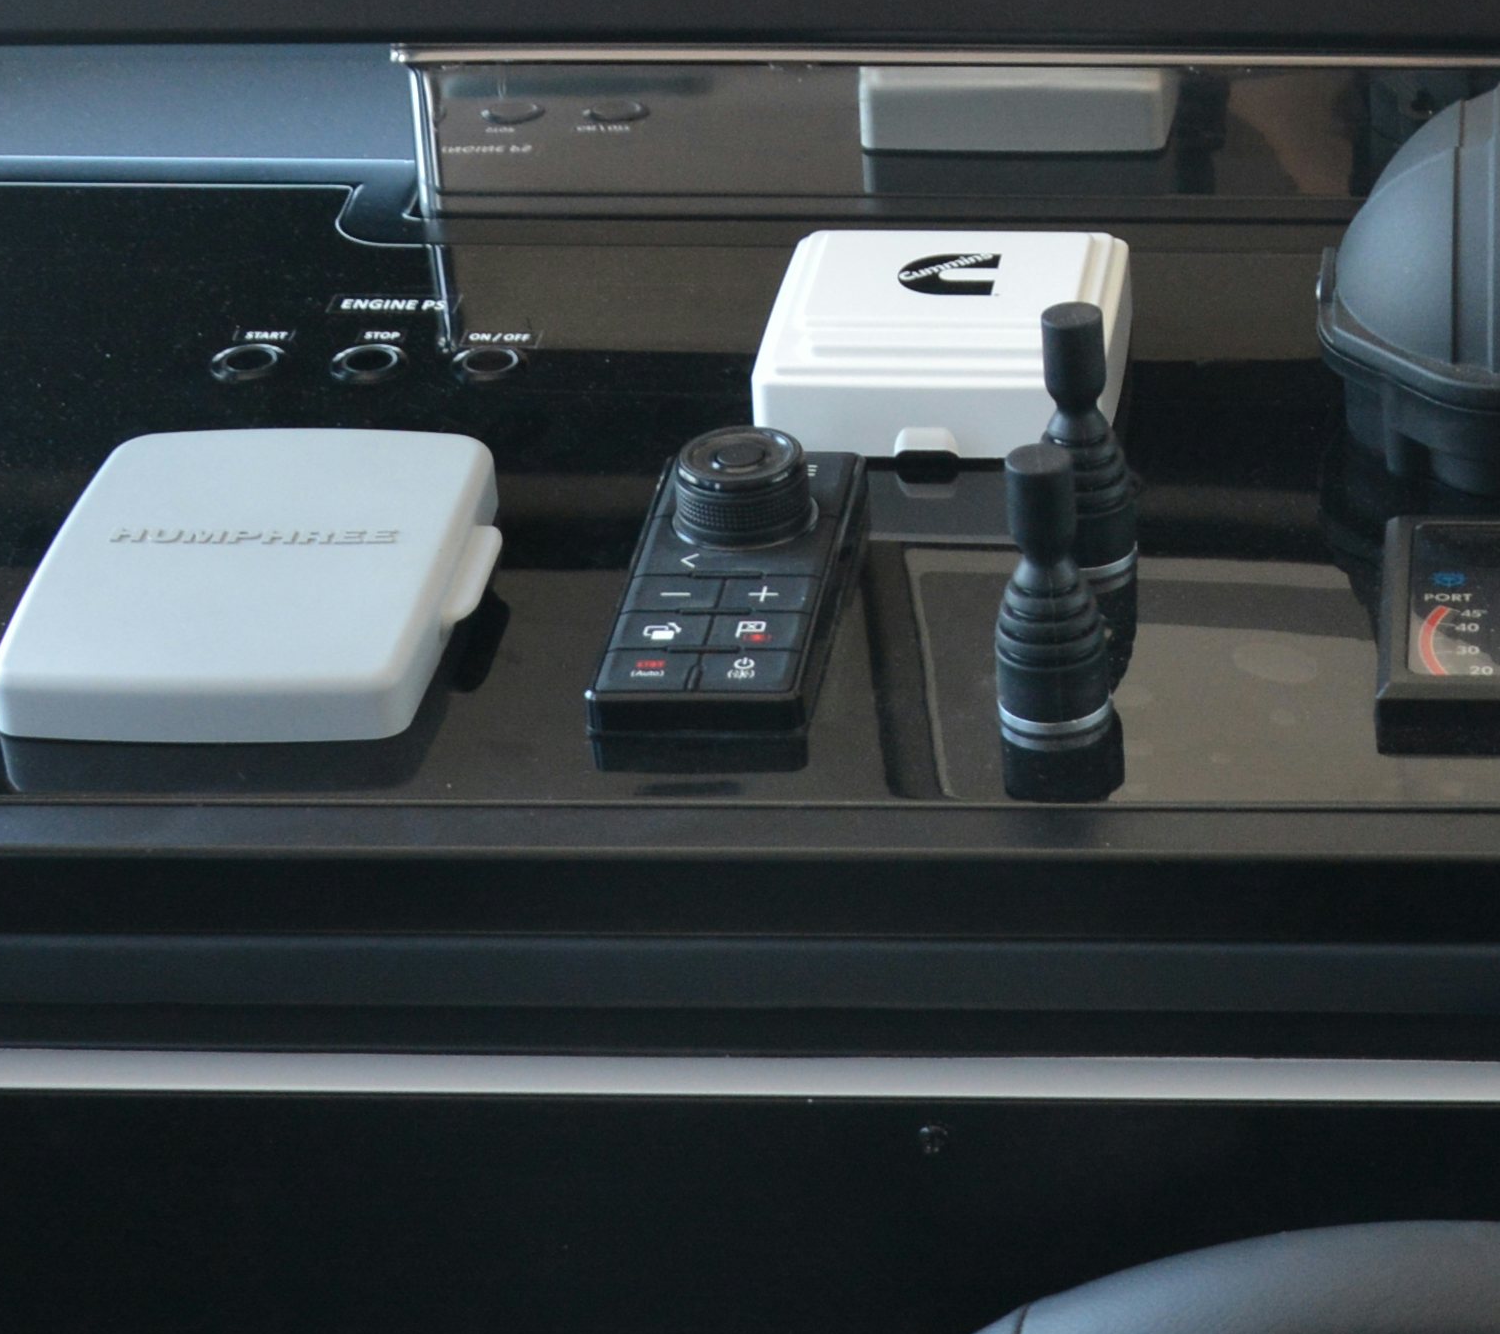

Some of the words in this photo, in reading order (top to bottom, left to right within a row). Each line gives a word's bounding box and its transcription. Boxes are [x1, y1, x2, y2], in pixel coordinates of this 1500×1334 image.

[898, 251, 994, 282] Cummins
[340, 298, 418, 311] ENGINE
[420, 299, 447, 312] PS
[245, 330, 289, 341] START
[363, 330, 401, 340] STOP
[469, 332, 492, 342] ON
[503, 333, 530, 342] OFF
[109, 527, 401, 545] HUMPHREE
[1424, 593, 1473, 603] PORT
[1456, 622, 1480, 632] 40
[1456, 645, 1480, 655] 30
[1469, 665, 1494, 675] 20
